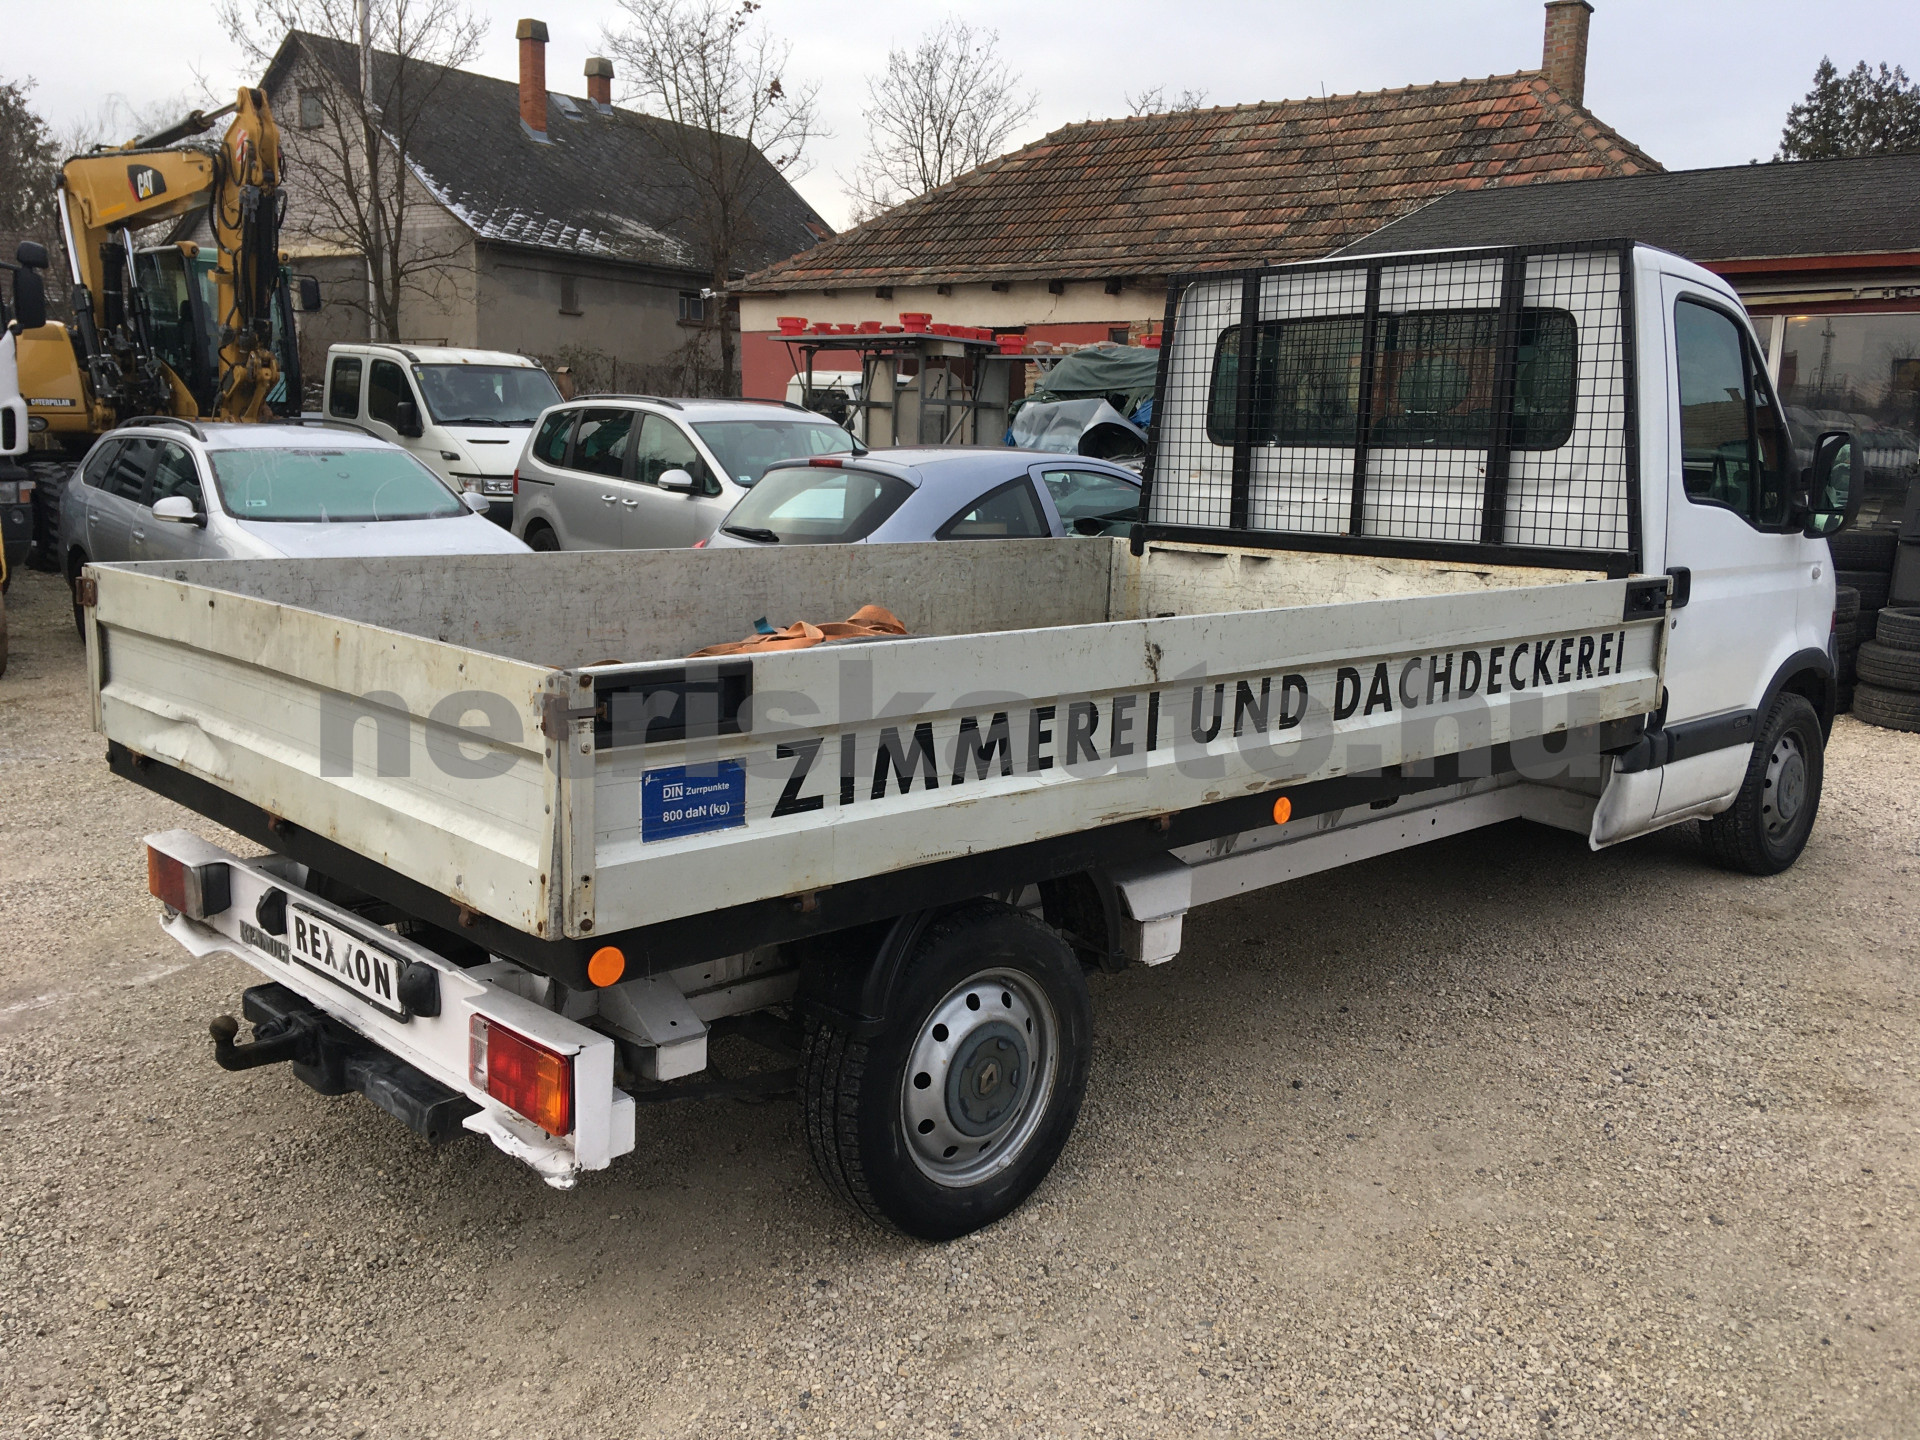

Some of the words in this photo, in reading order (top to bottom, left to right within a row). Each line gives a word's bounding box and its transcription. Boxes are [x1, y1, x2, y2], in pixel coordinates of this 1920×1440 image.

[137, 170, 153, 198] CAT
[31, 398, 71, 406] CATERPILLAR
[771, 691, 1160, 818] ZIMMEREI
[1190, 673, 1309, 744] UND
[1333, 631, 1626, 721] DACHDECKEREI
[663, 783, 683, 802] DIN
[686, 783, 730, 796] Zurrpunkte
[663, 809, 683, 822] 800
[685, 805, 707, 819] daN
[709, 801, 730, 817] (kg)
[239, 919, 291, 966] RENAULT
[294, 915, 392, 1001] REXXON
